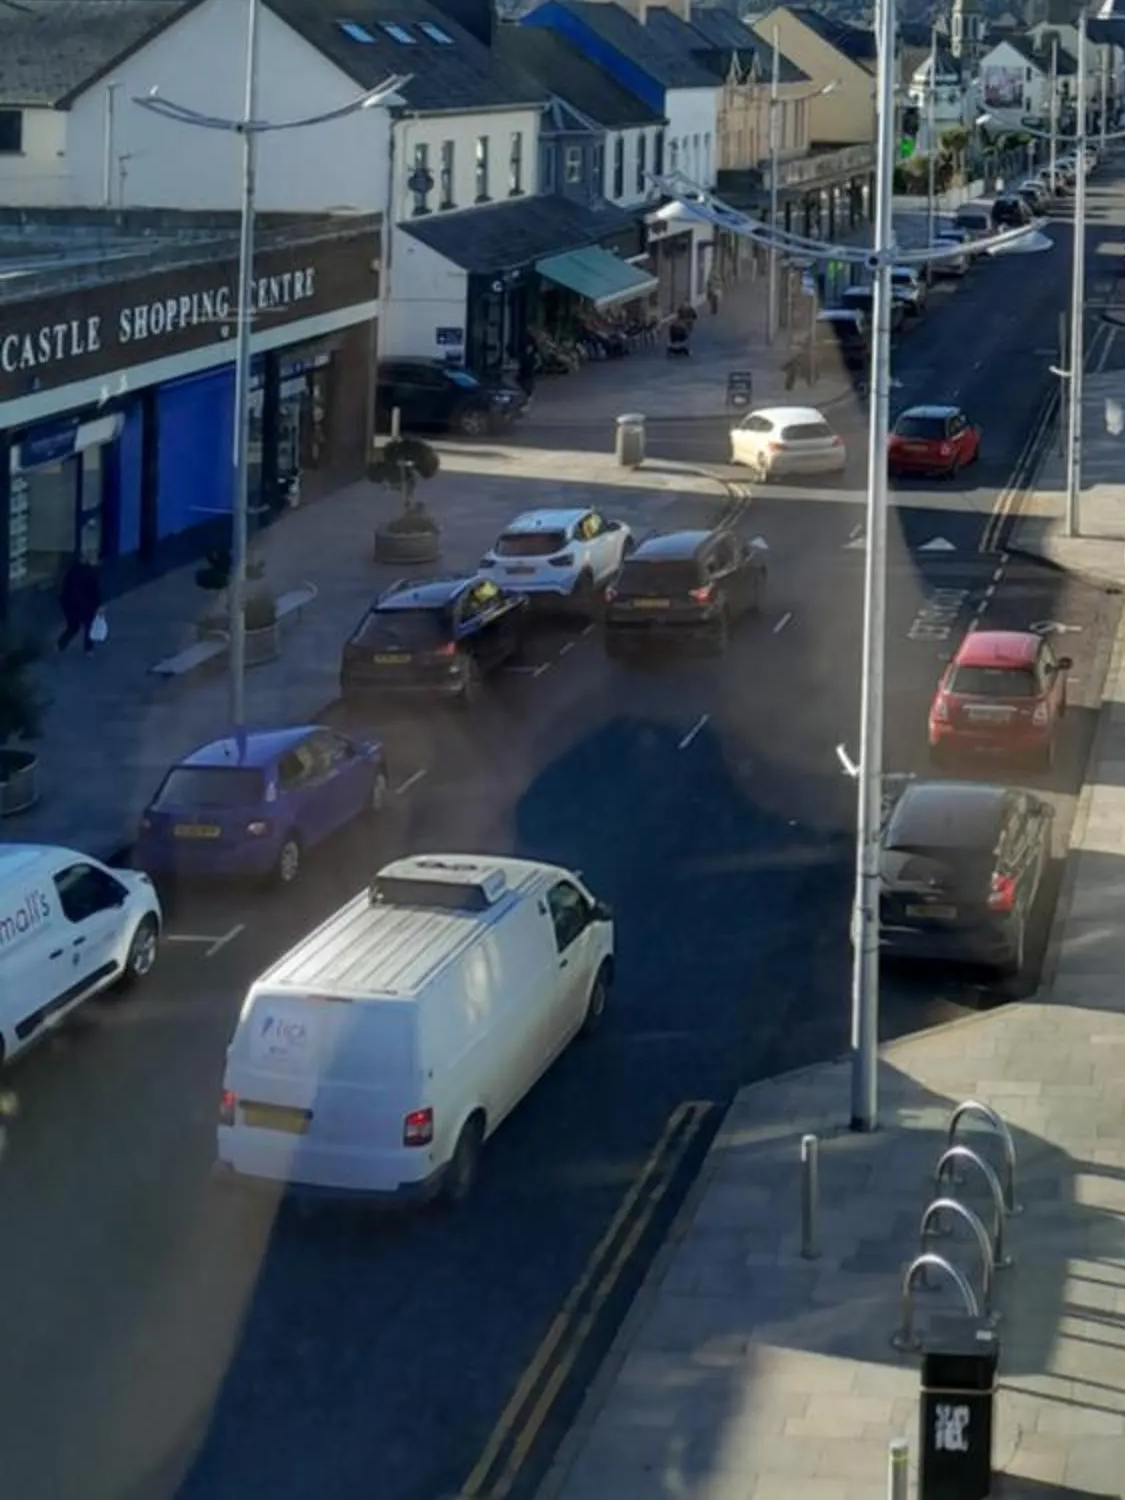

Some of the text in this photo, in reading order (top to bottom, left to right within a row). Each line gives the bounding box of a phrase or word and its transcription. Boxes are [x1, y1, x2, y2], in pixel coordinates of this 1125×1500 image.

[0, 315, 101, 373] CASTLE
[118, 285, 230, 344] SHOPPING
[0, 889, 51, 944] mall's
